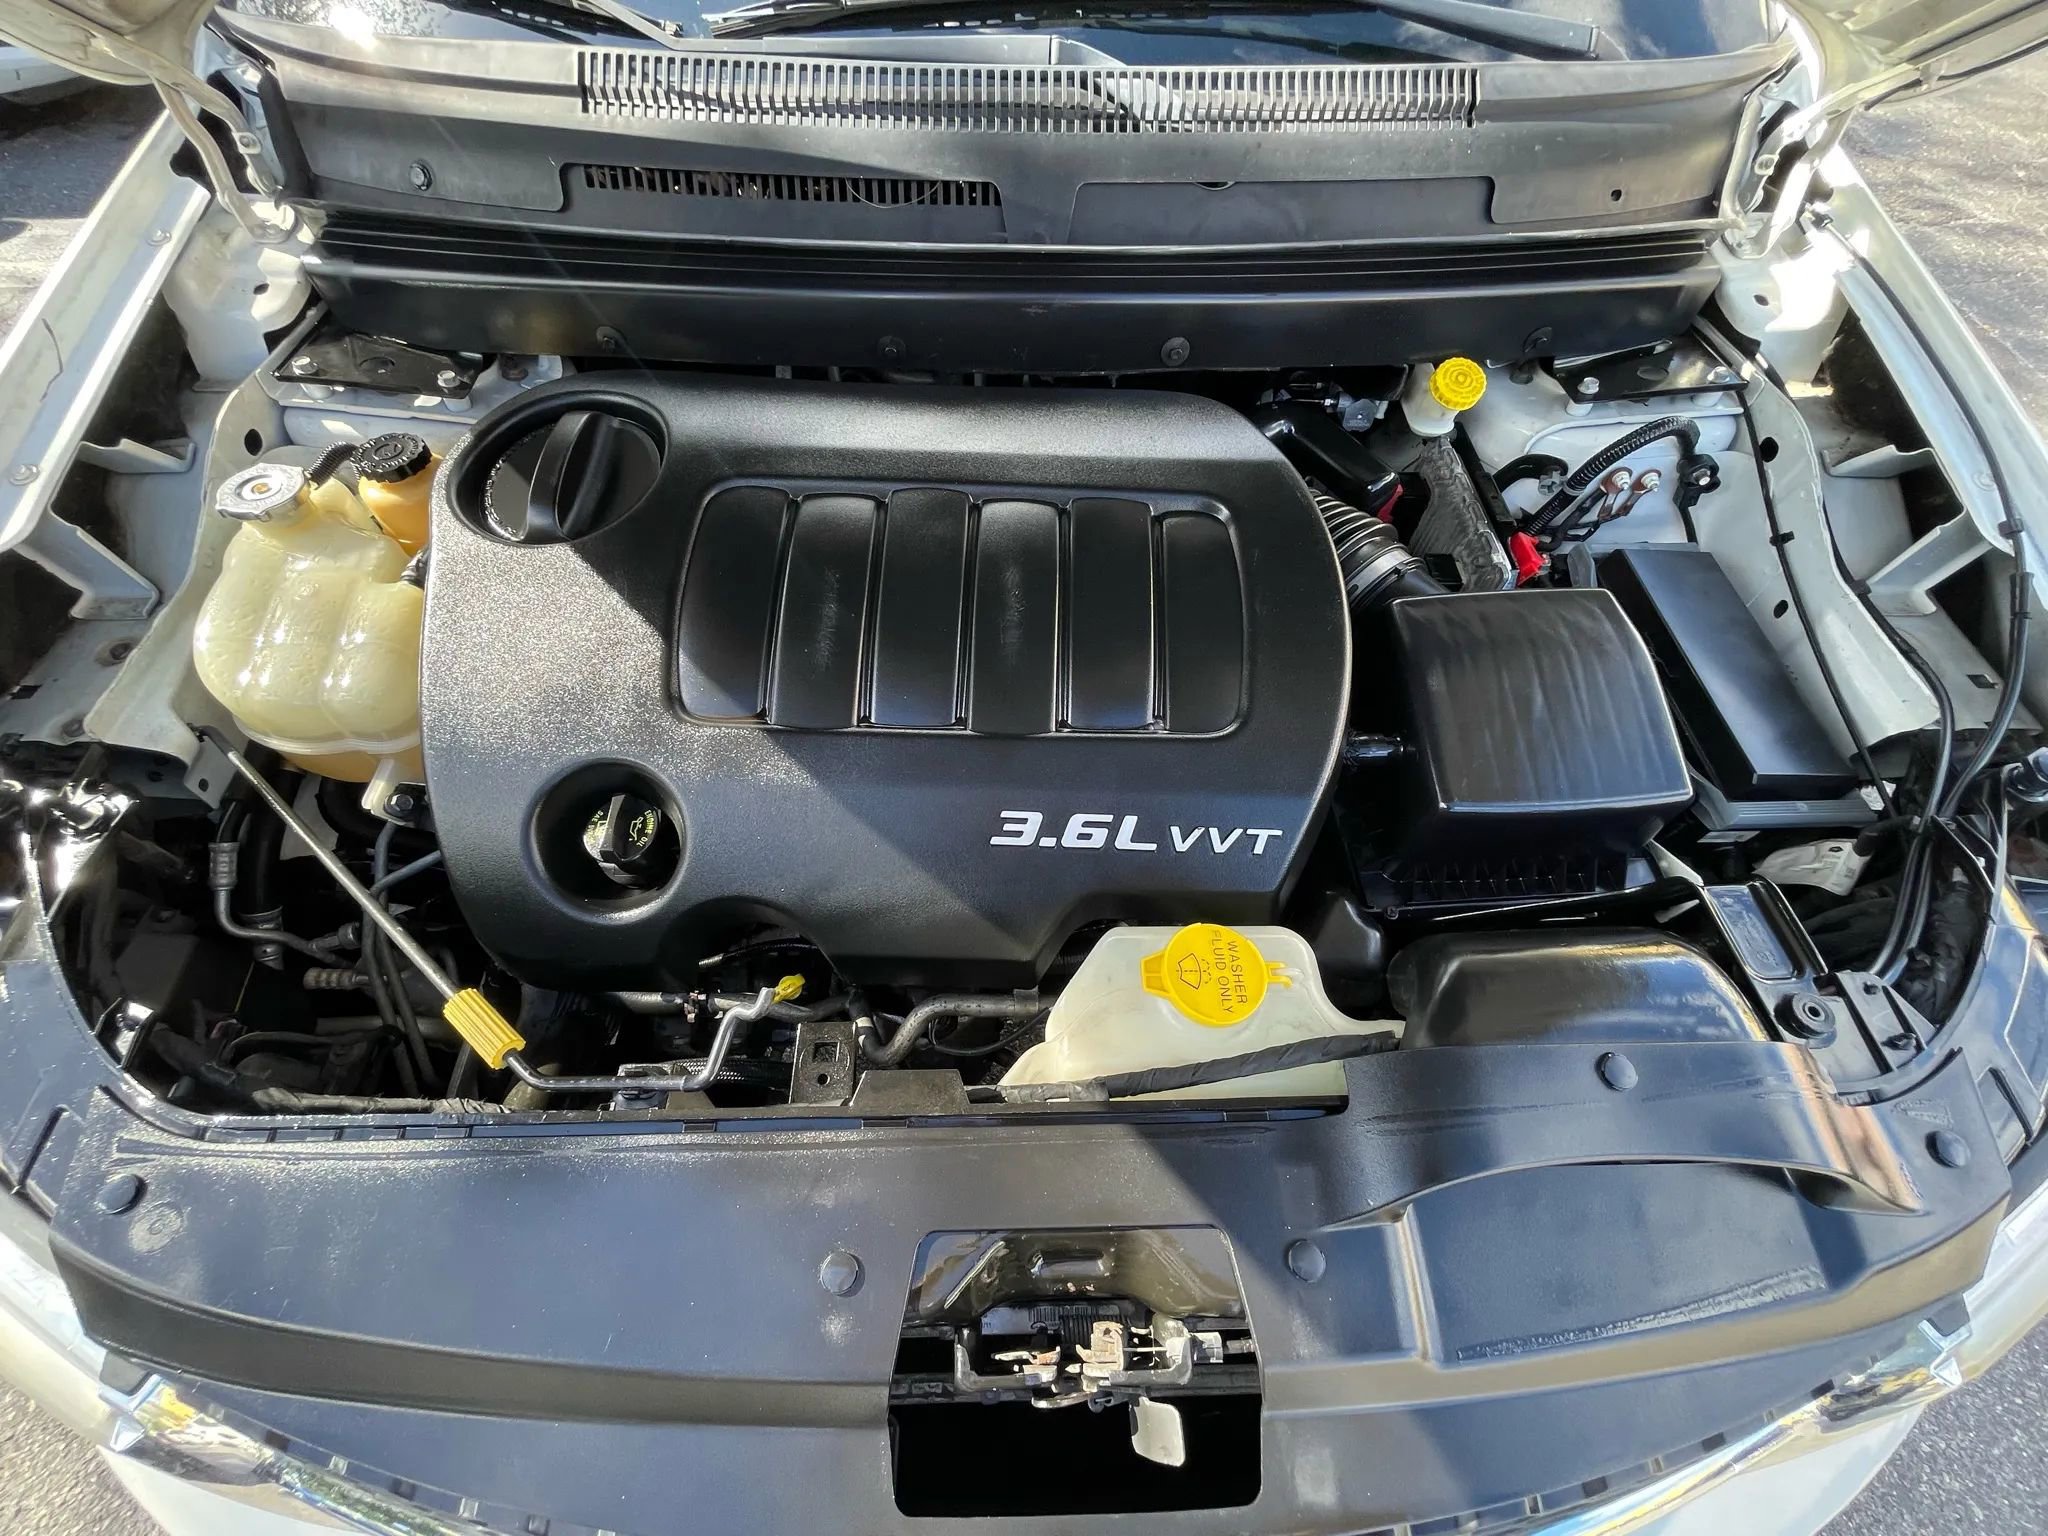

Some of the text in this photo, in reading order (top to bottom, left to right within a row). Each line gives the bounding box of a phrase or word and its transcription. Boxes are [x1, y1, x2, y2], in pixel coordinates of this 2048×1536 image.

[591, 810, 604, 822] SAE
[636, 809, 654, 847] ENGINE OIL
[990, 810, 1283, 855] 3.6L VVT
[1211, 929, 1234, 1014] FLUID ONLY
[1227, 940, 1248, 1004] WASHER
